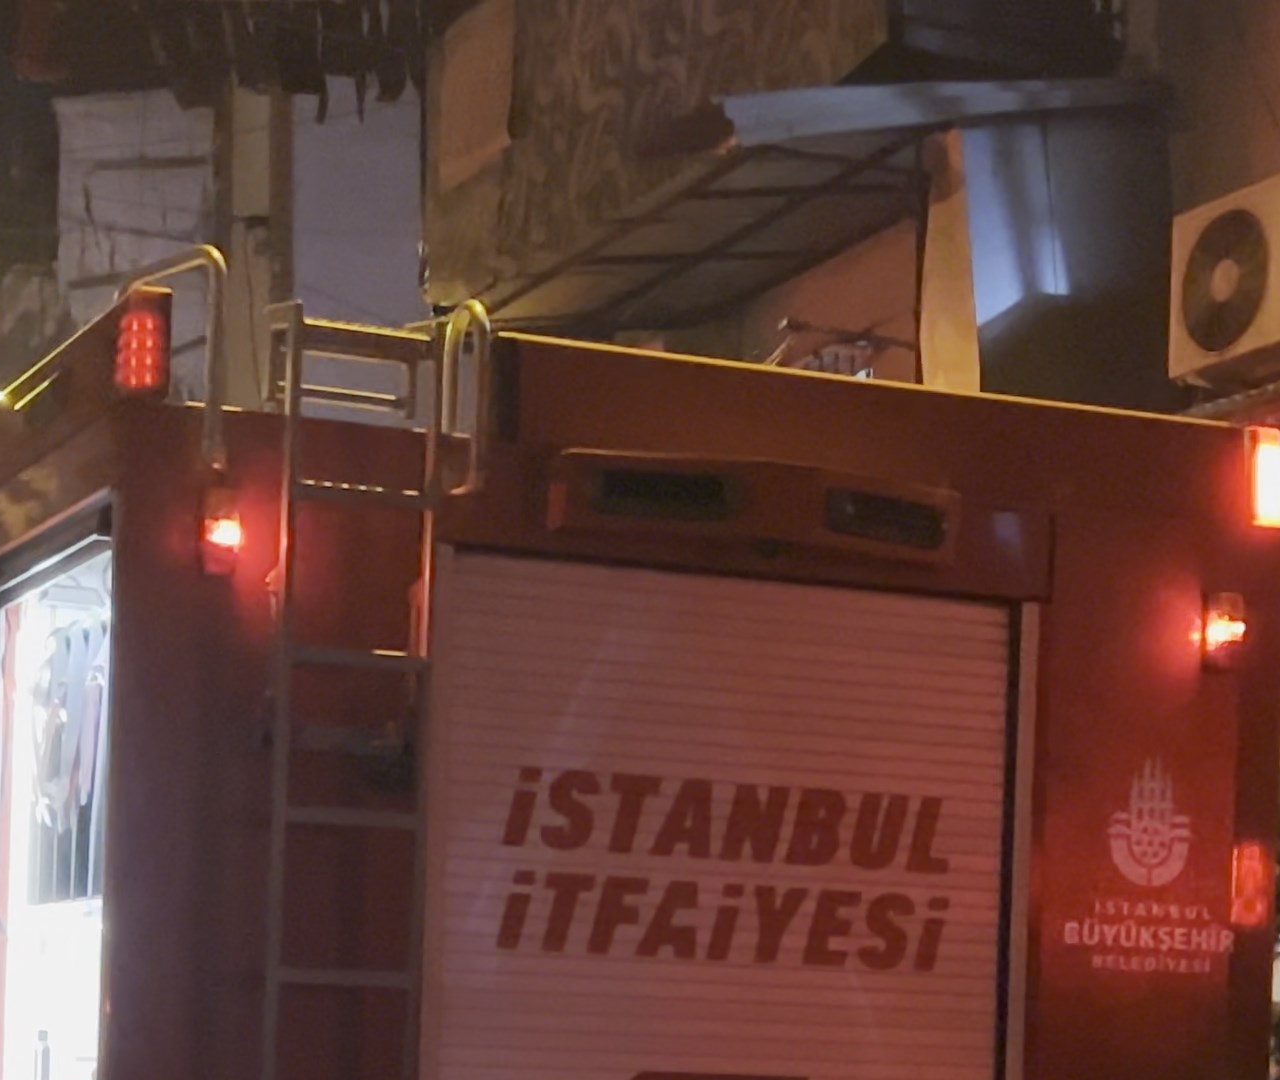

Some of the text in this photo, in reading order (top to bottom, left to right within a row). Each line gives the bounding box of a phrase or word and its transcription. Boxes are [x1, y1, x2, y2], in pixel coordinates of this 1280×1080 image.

[501, 766, 950, 875] İSTANBUL
[496, 869, 950, 973] İTFAİYESİ
[1063, 917, 1236, 953] BÜYÜKŞEHİR
